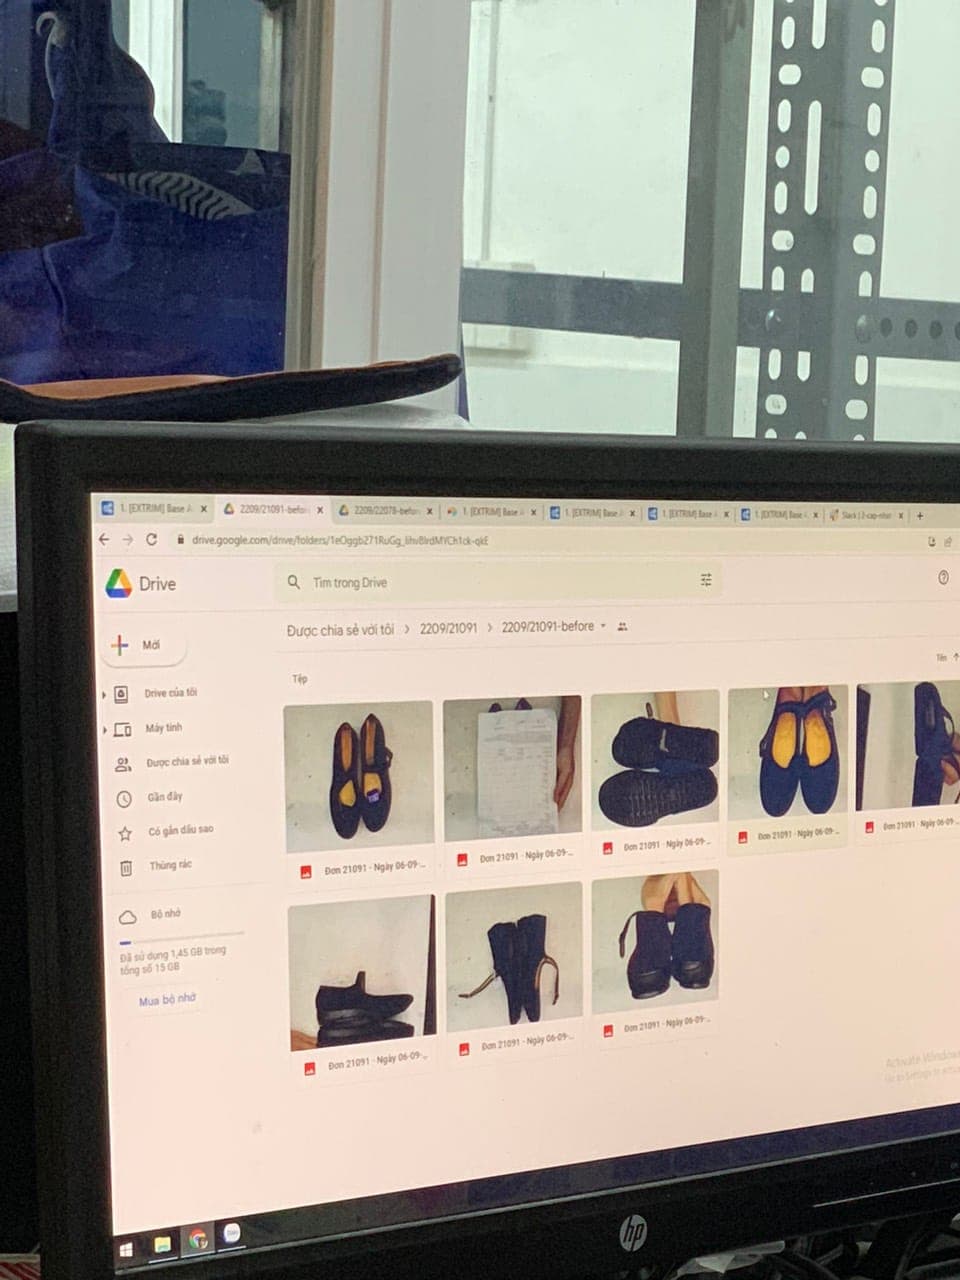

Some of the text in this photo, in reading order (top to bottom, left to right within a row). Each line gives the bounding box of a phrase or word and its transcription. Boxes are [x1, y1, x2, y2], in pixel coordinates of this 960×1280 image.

[140, 576, 176, 592] Drive
[331, 578, 360, 591] trong
[362, 577, 388, 589] Drive
[320, 624, 343, 637] chia
[420, 622, 478, 634] 2209/21091
[502, 620, 594, 633] 2209/21091-before
[144, 688, 167, 698] Drive
[172, 757, 190, 767] chia
[897, 820, 915, 830] 21091
[772, 830, 792, 840] 21091
[639, 840, 660, 850] 21091
[496, 852, 519, 862] 21091
[343, 864, 367, 874] 21091
[190, 947, 203, 957] GB
[155, 963, 166, 973] 15
[167, 962, 180, 972] GB
[139, 996, 160, 1007] Mua
[639, 1021, 660, 1032] 21091
[498, 1038, 520, 1049] 21091
[346, 1058, 370, 1069] 21091
[621, 1215, 646, 1252] hp
